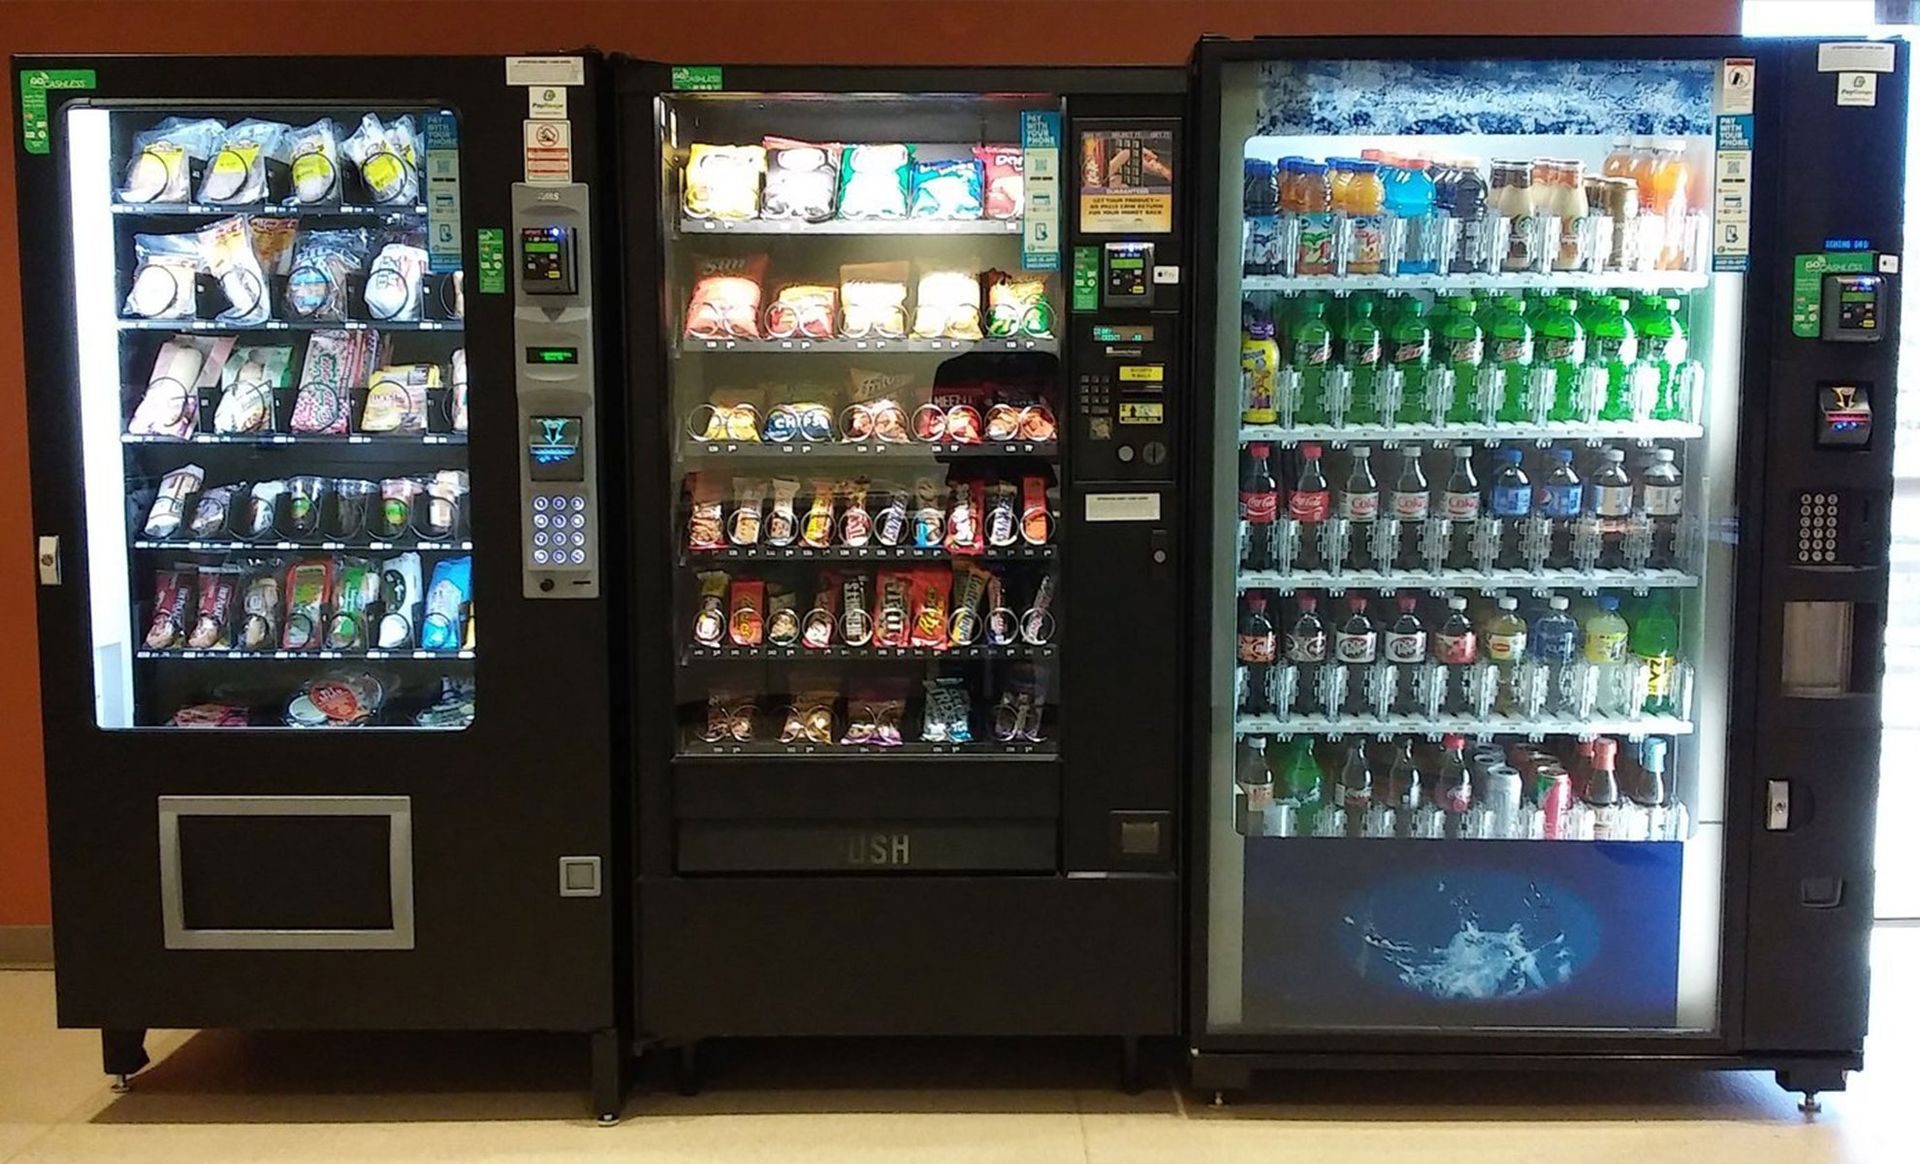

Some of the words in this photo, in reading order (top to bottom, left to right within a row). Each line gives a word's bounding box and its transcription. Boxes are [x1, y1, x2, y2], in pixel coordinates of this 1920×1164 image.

[1720, 117, 1736, 125] PAY
[1720, 124, 1742, 132] WITH
[1720, 131, 1743, 140] YOUR
[1720, 138, 1748, 147] PHONE
